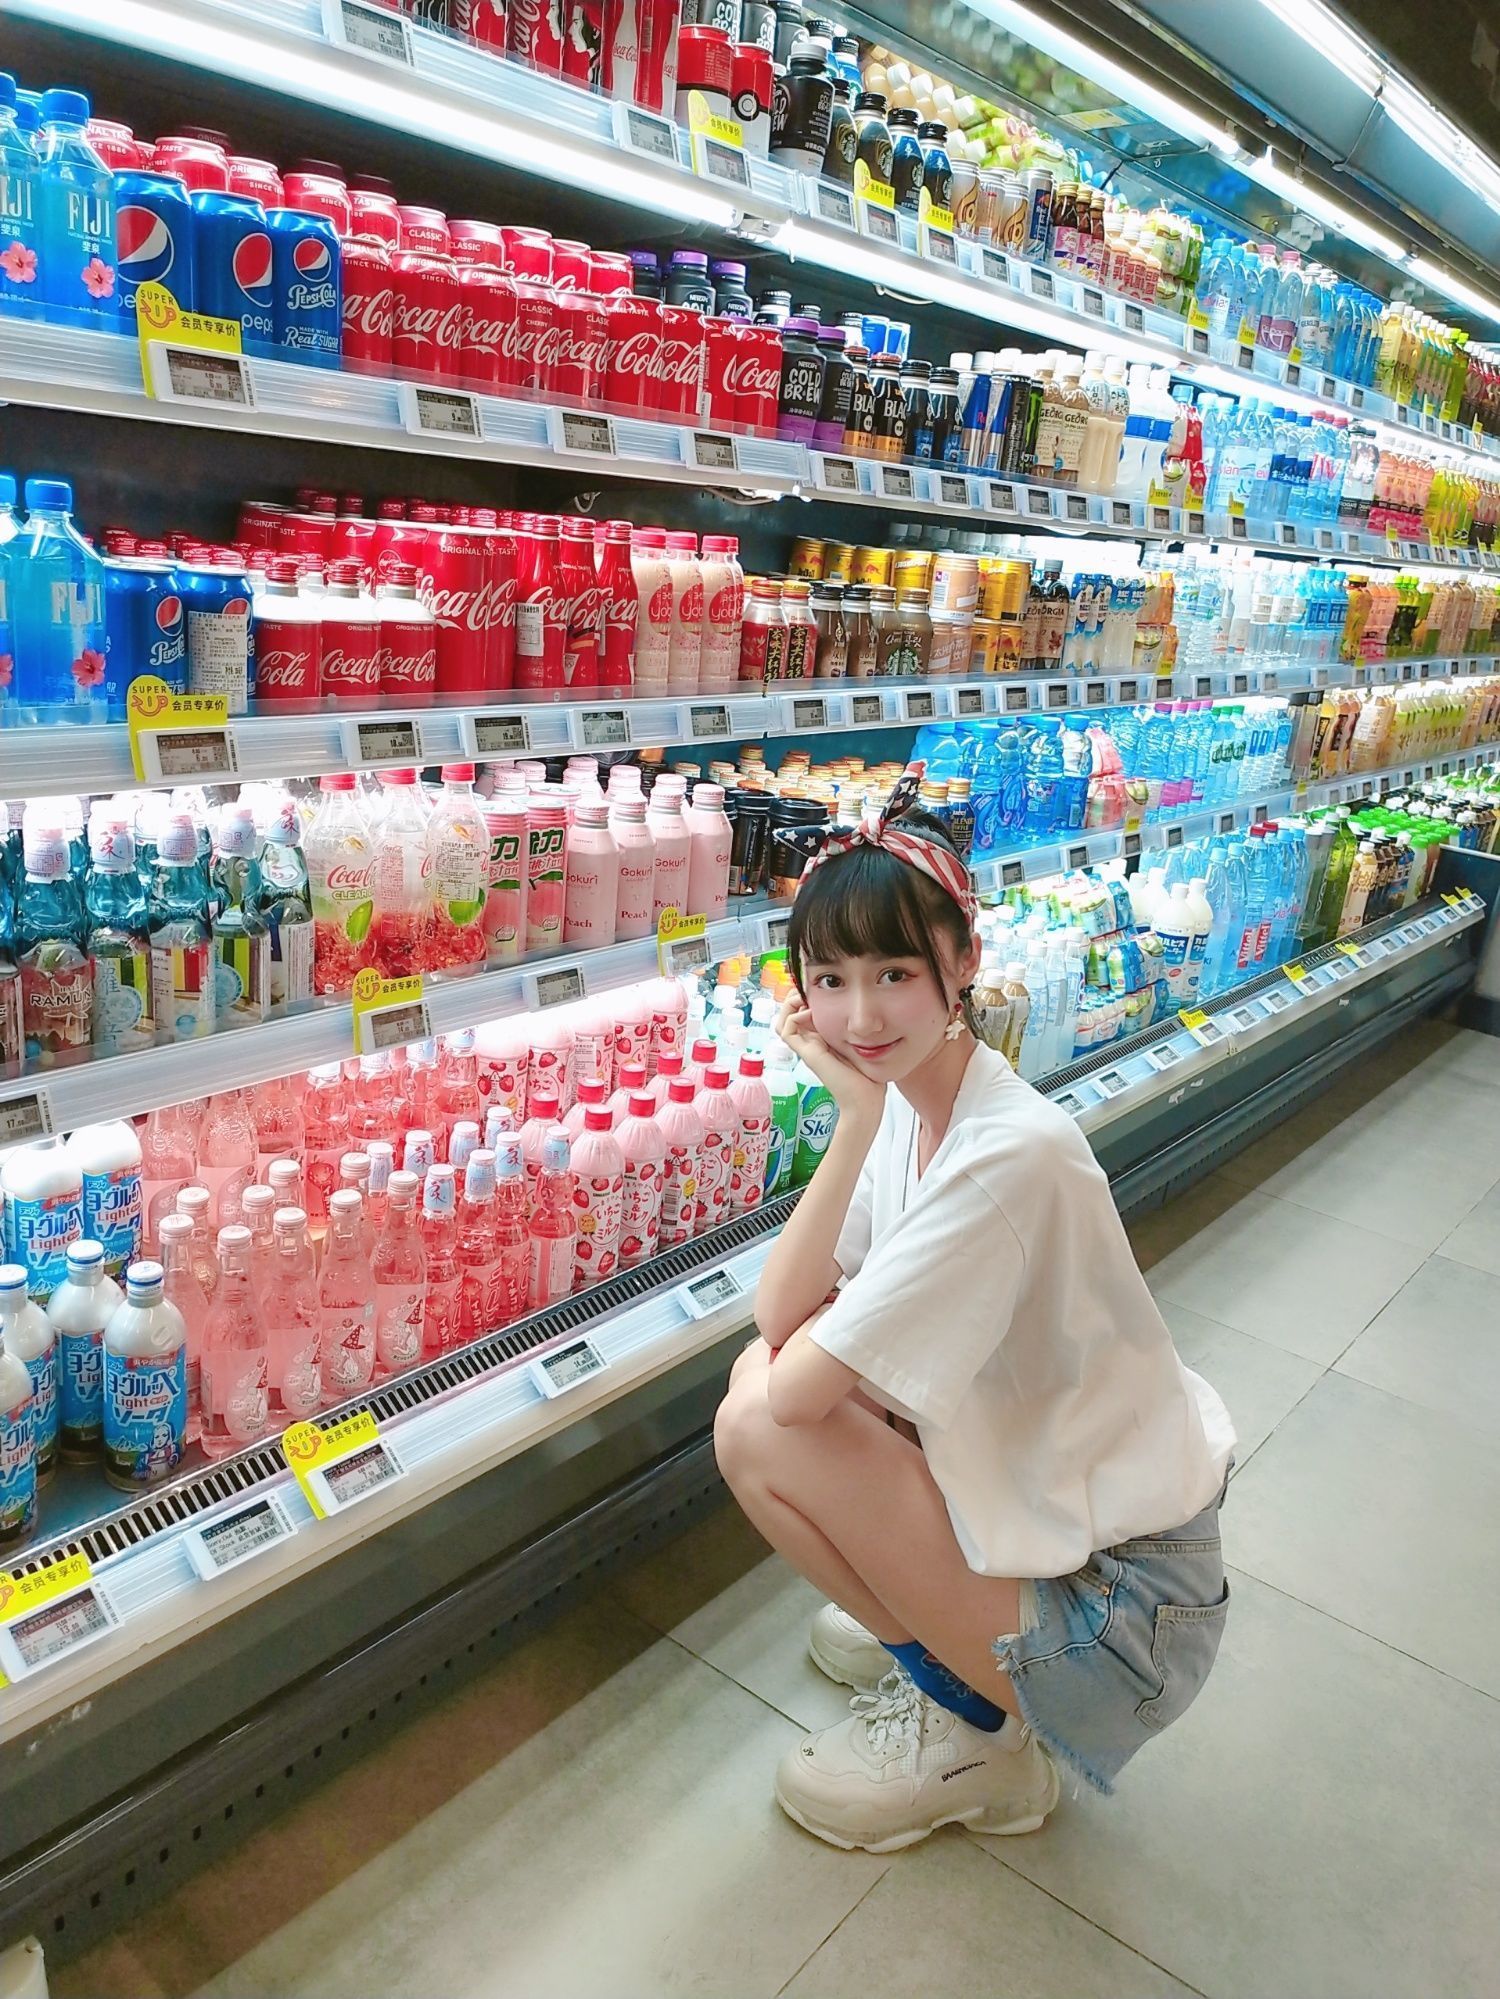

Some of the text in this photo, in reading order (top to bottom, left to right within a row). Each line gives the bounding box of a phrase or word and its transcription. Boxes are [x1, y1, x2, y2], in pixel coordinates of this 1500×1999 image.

[67, 191, 112, 238] FIJI
[409, 229, 443, 242] CLASSIC
[450, 241, 481, 252] CLASSIC
[421, 274, 445, 284] SINCE
[140, 288, 174, 307] SUPER
[520, 303, 553, 316] CLASSIC
[180, 316, 236, 338] 会员专享价
[281, 326, 339, 350] Real SUGAR
[789, 368, 821, 387] COLD
[440, 545, 481, 556] ORIGINAL
[132, 685, 168, 695] SUPER
[172, 699, 225, 712] 会员专享价
[655, 857, 686, 868] Gokuri
[621, 866, 652, 878] Gokuri
[332, 890, 368, 900] CLEAR
[654, 899, 681, 909] Peach
[621, 909, 648, 919] Peach
[1239, 930, 1253, 963] Vittel
[1255, 923, 1272, 957] Vittel
[356, 975, 379, 985] SUPER
[382, 978, 421, 994] 会员专享价
[622, 1190, 651, 1203] いちご
[596, 1203, 620, 1219] いちご
[632, 1204, 640, 1212] &
[97, 1208, 130, 1222] Light
[622, 1210, 649, 1221] ミルク
[597, 1223, 620, 1240] ミルク
[31, 1238, 65, 1251] Light
[107, 1367, 179, 1397] ヨーグルッペ
[115, 1394, 149, 1410] Light
[285, 1427, 316, 1446] SUPER
[325, 1416, 372, 1445] 会员专享价
[219, 1540, 236, 1551] Stock
[20, 1560, 84, 1595] 会员专享价
